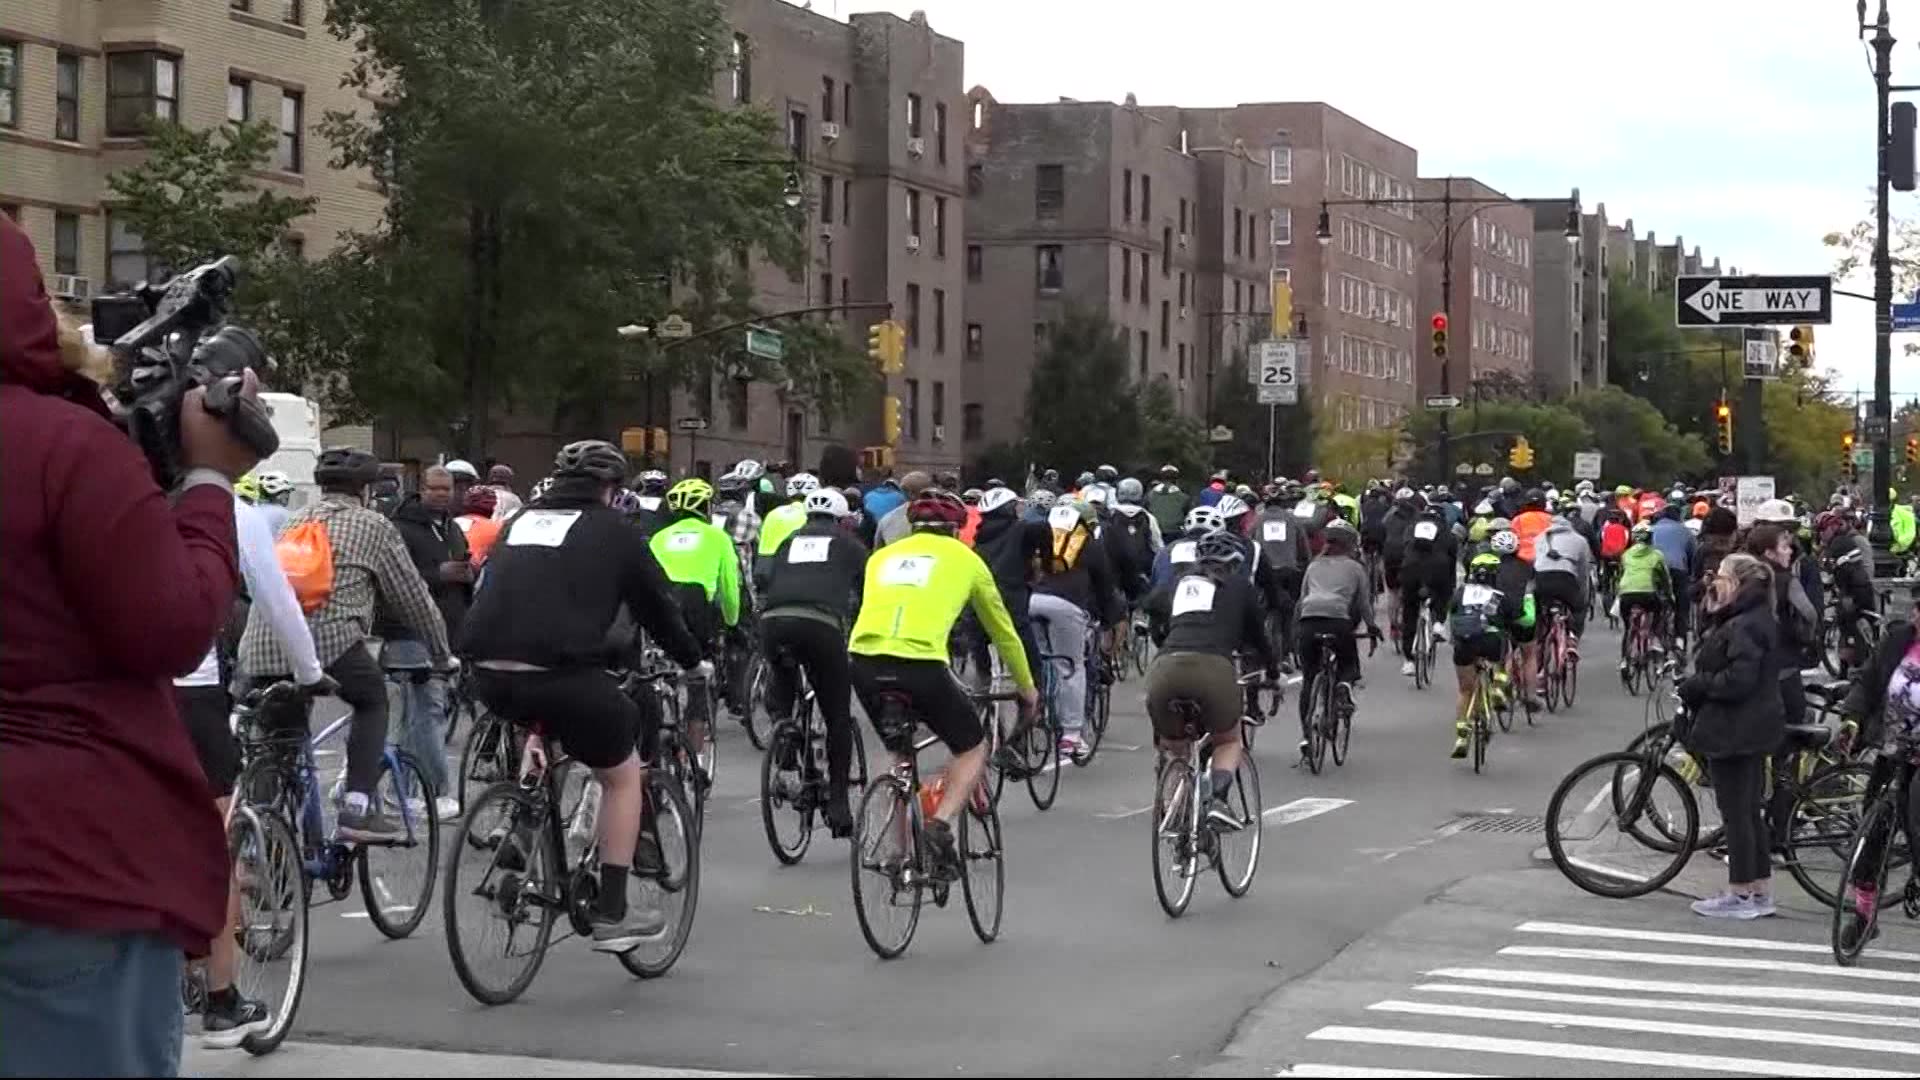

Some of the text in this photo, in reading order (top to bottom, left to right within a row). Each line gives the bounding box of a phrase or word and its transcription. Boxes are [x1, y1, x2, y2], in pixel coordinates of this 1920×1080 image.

[1701, 291, 1810, 310] ONE WAY
[1264, 366, 1292, 383] 25
